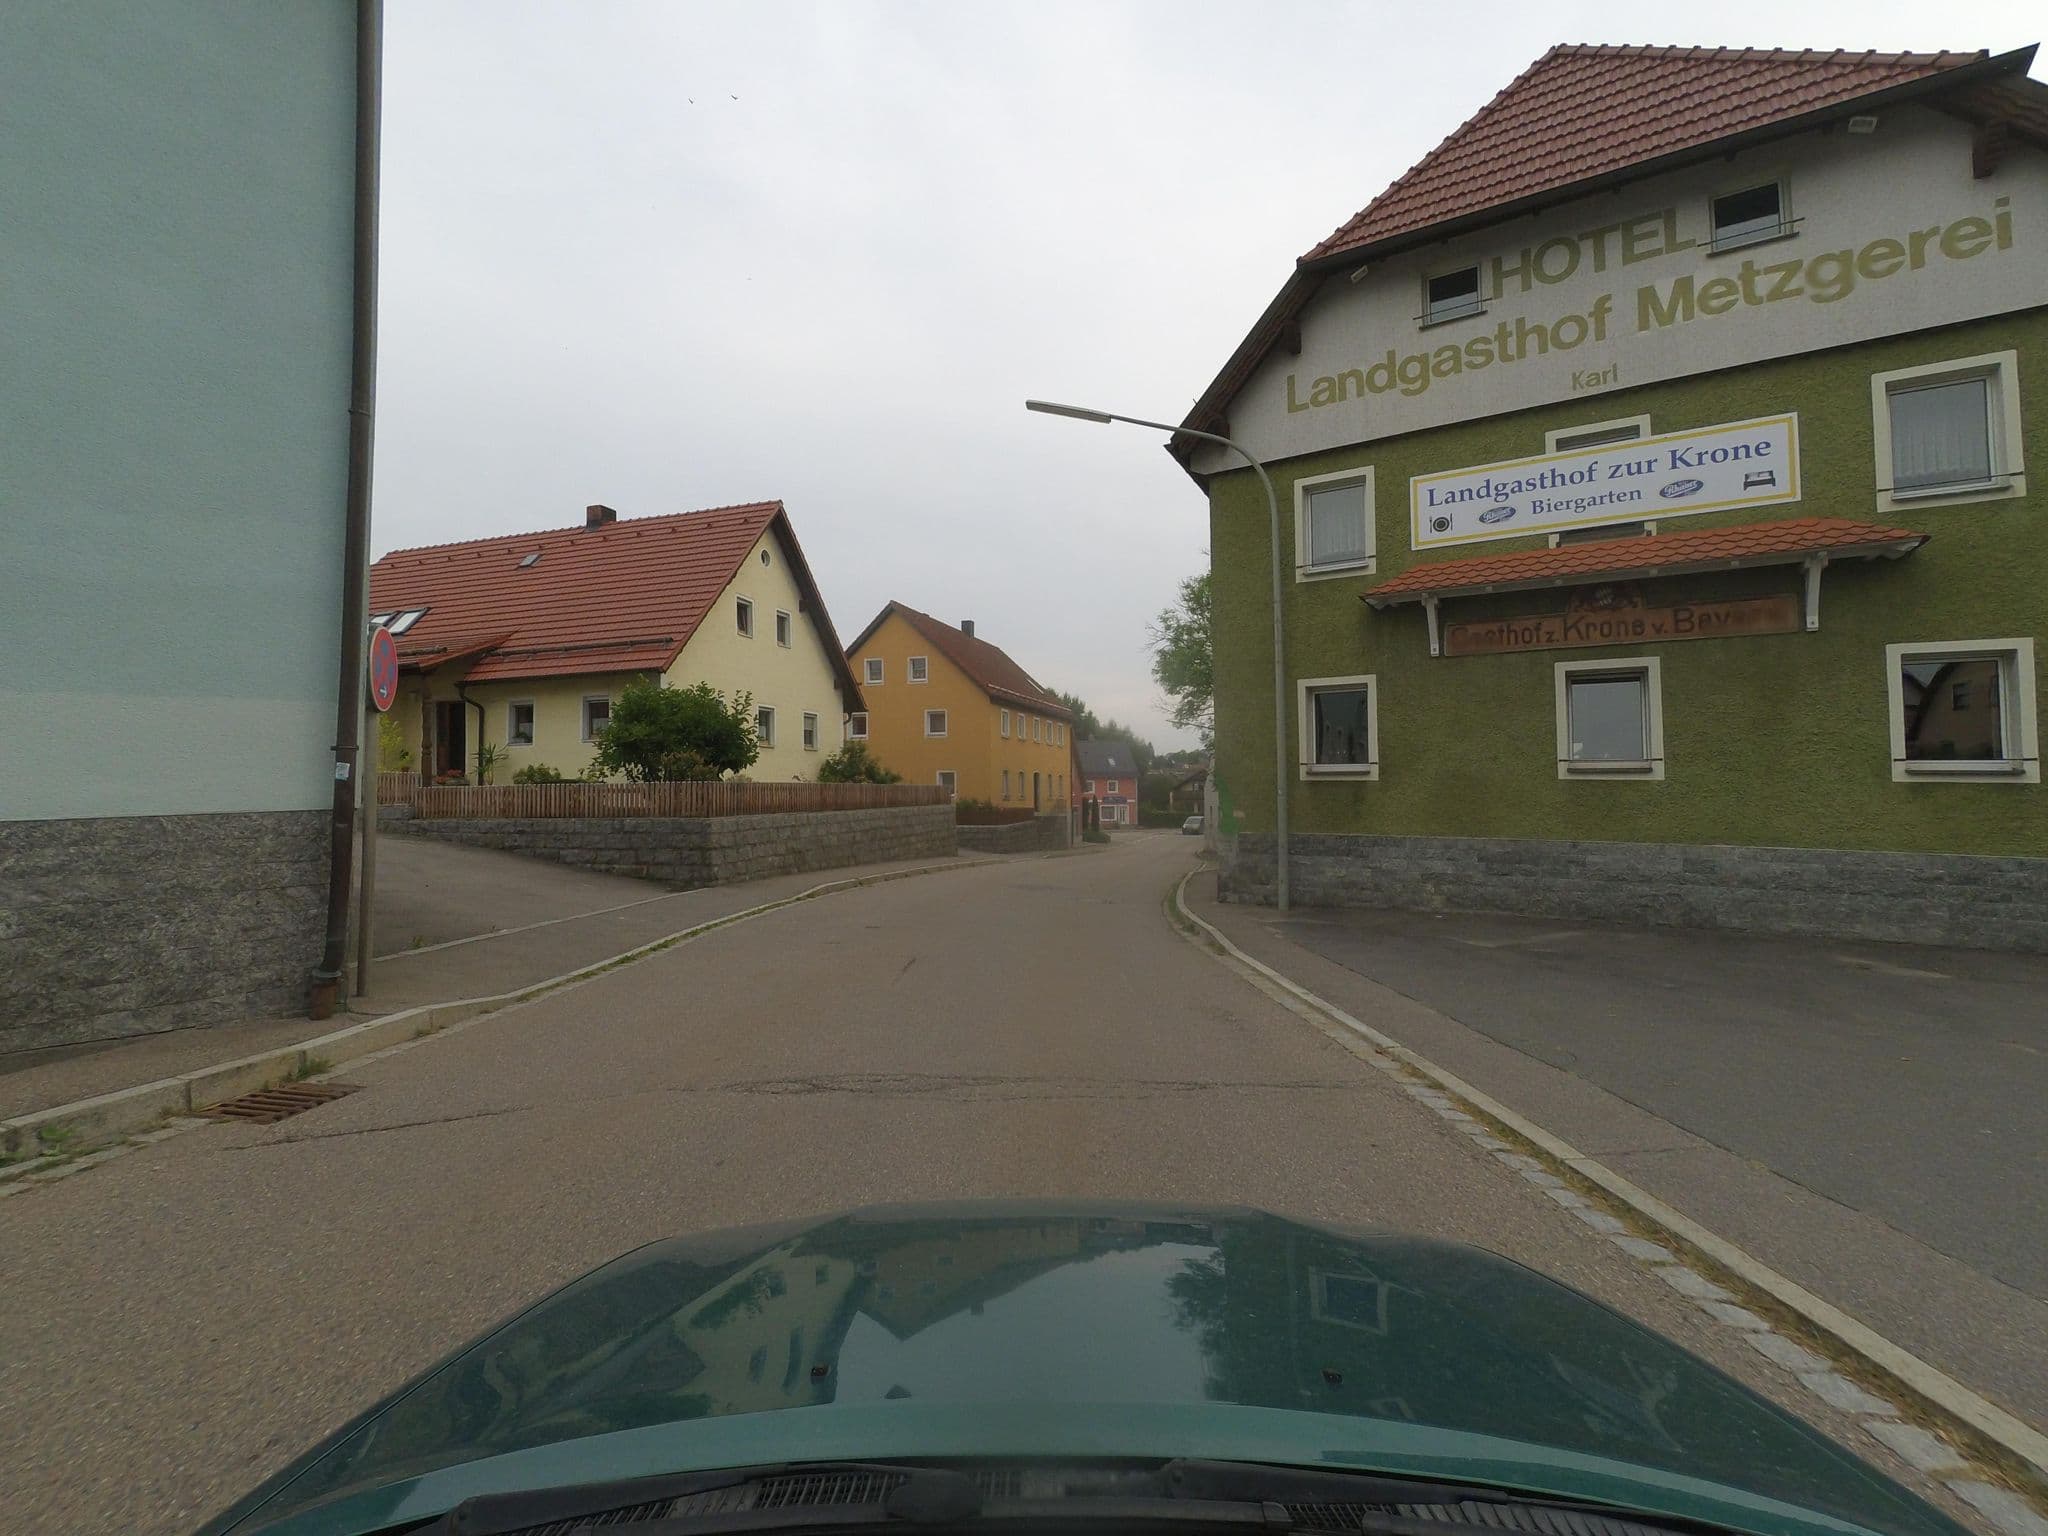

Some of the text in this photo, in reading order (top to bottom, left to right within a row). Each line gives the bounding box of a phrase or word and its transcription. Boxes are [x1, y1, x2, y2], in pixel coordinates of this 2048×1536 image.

[1492, 208, 1697, 299] HOTEL
[1287, 198, 2013, 413] Landgasthof Metzgerei
[1572, 363, 1618, 391] Karl
[1428, 441, 1771, 507] Landgasthof zur Krone
[1531, 489, 1641, 513] Biergarten
[1563, 615, 1645, 641] Krone
